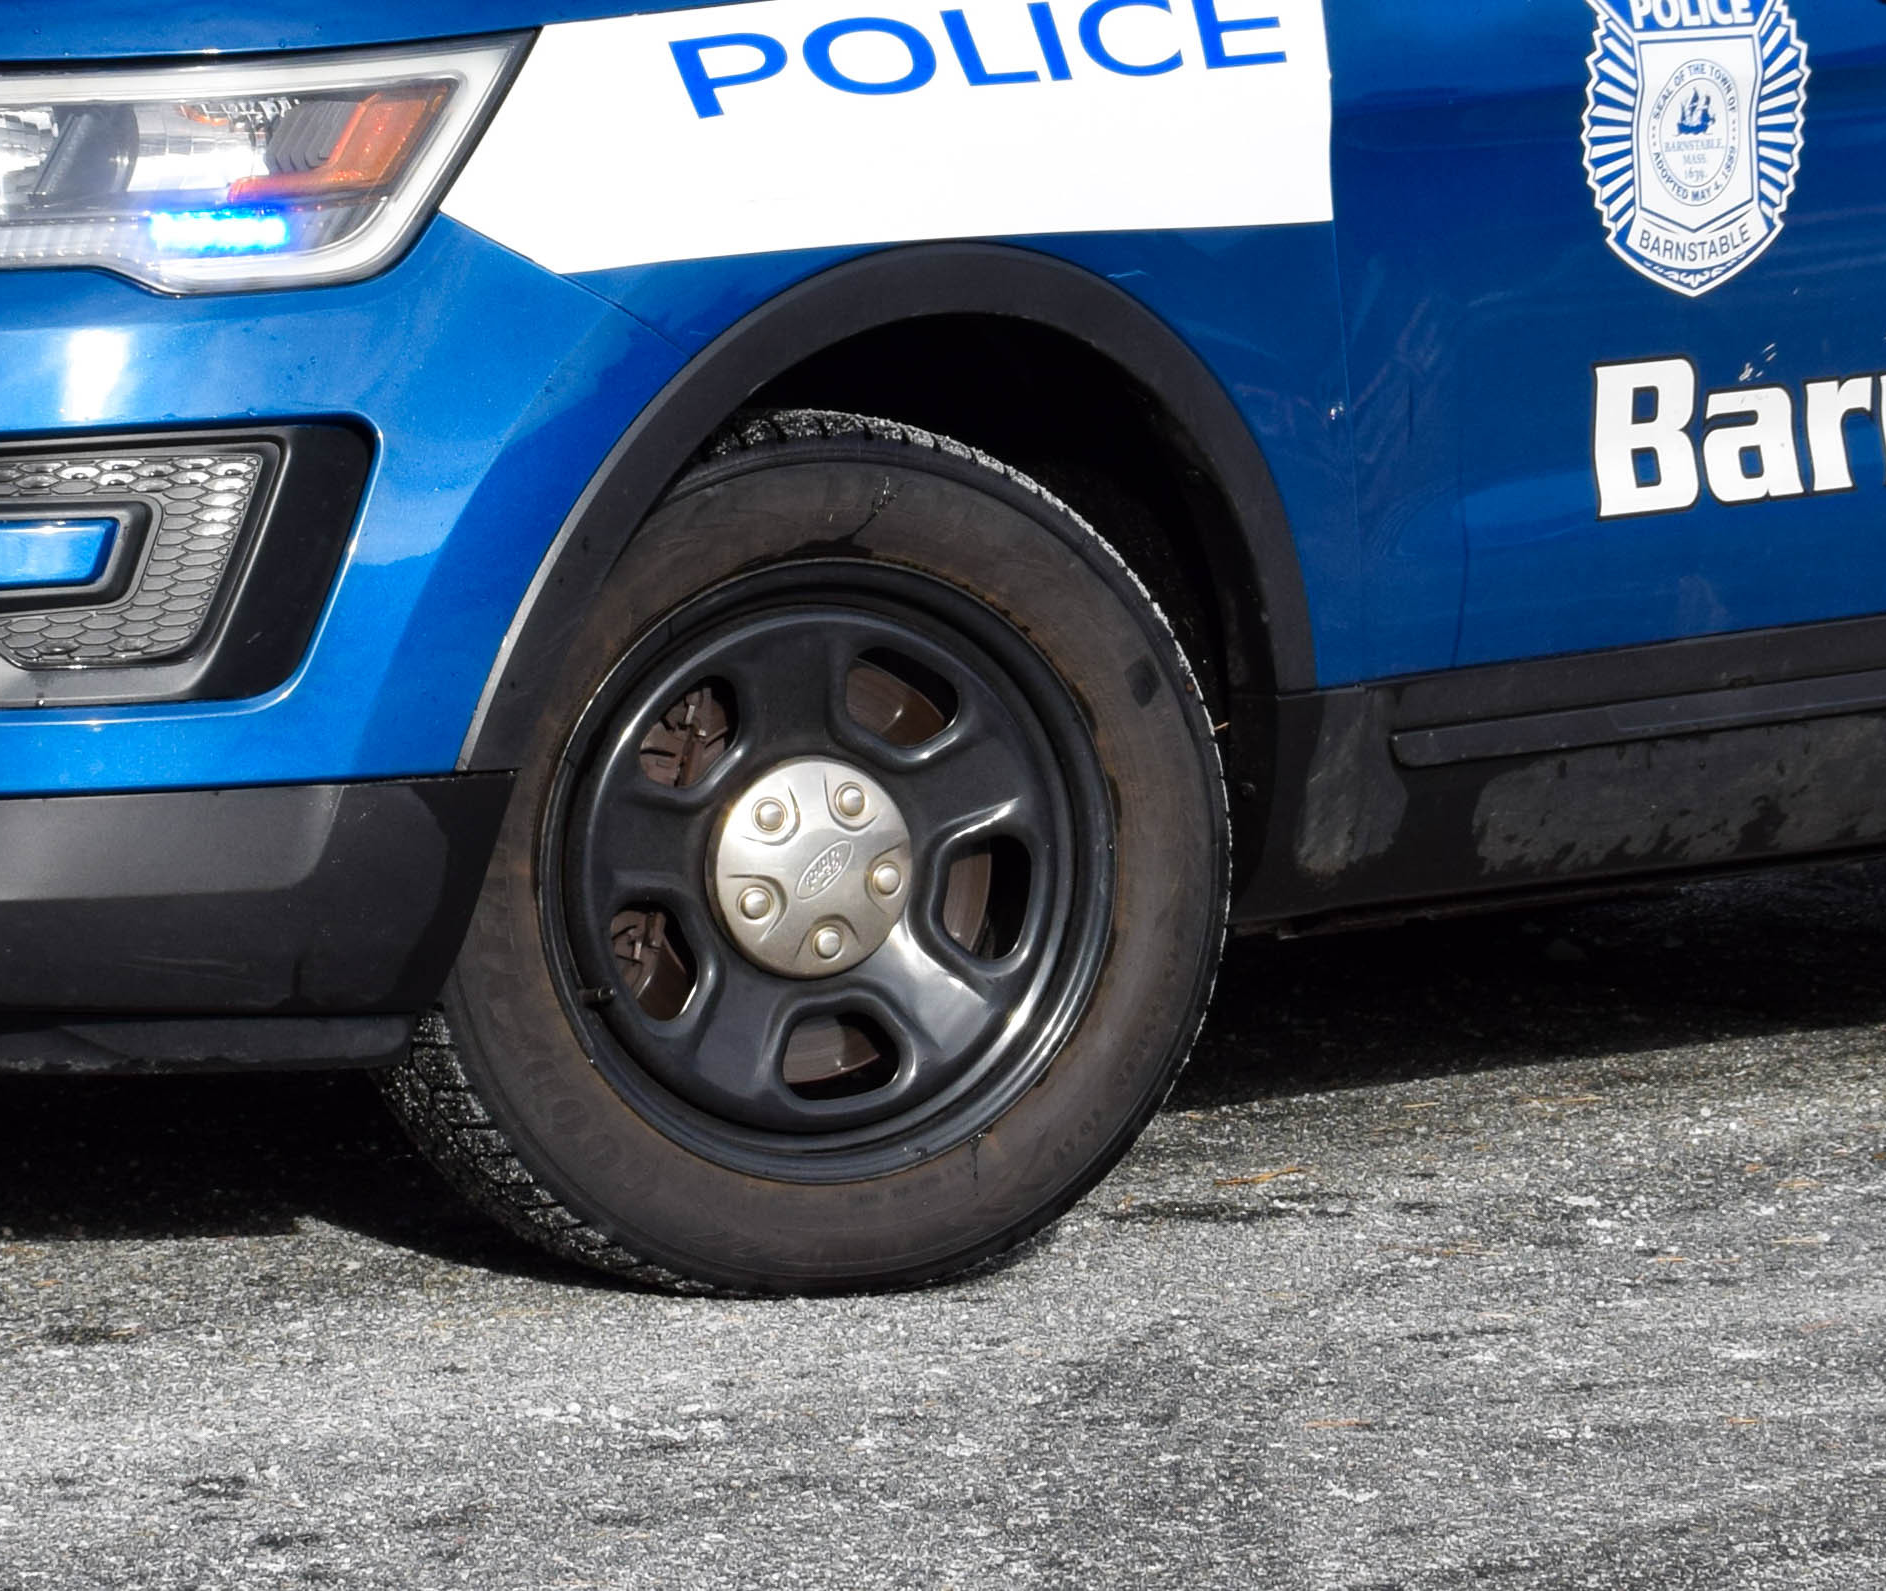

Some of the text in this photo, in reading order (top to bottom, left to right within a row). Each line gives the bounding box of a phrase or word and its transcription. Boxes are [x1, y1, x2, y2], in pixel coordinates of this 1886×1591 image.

[1674, 69, 1684, 86] OF
[1687, 63, 1706, 76] THE
[1708, 65, 1732, 95] TOWN
[1653, 152, 1689, 199] ADOPTED
[1691, 186, 1711, 201] MAY
[1639, 223, 1751, 263] BARNSTABLE
